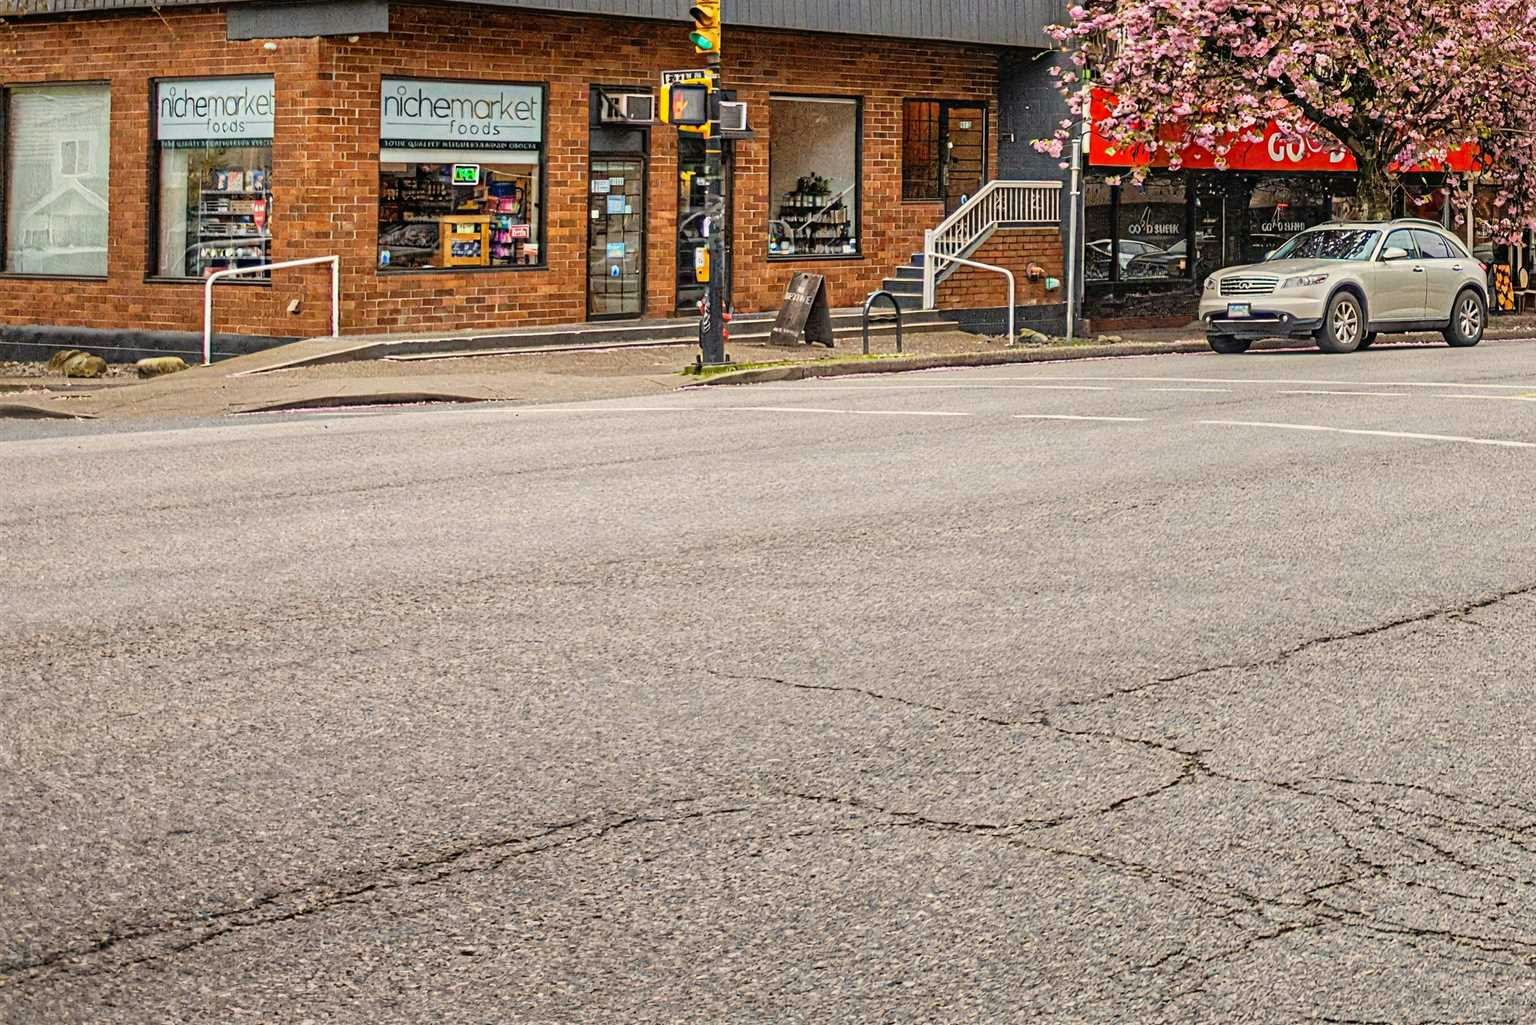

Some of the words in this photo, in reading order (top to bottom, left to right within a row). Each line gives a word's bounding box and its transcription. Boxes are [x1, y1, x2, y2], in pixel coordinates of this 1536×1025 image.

[161, 86, 275, 118] nichemarket
[384, 85, 538, 121] nichemarket
[207, 118, 245, 133] foods
[450, 119, 500, 135] foods
